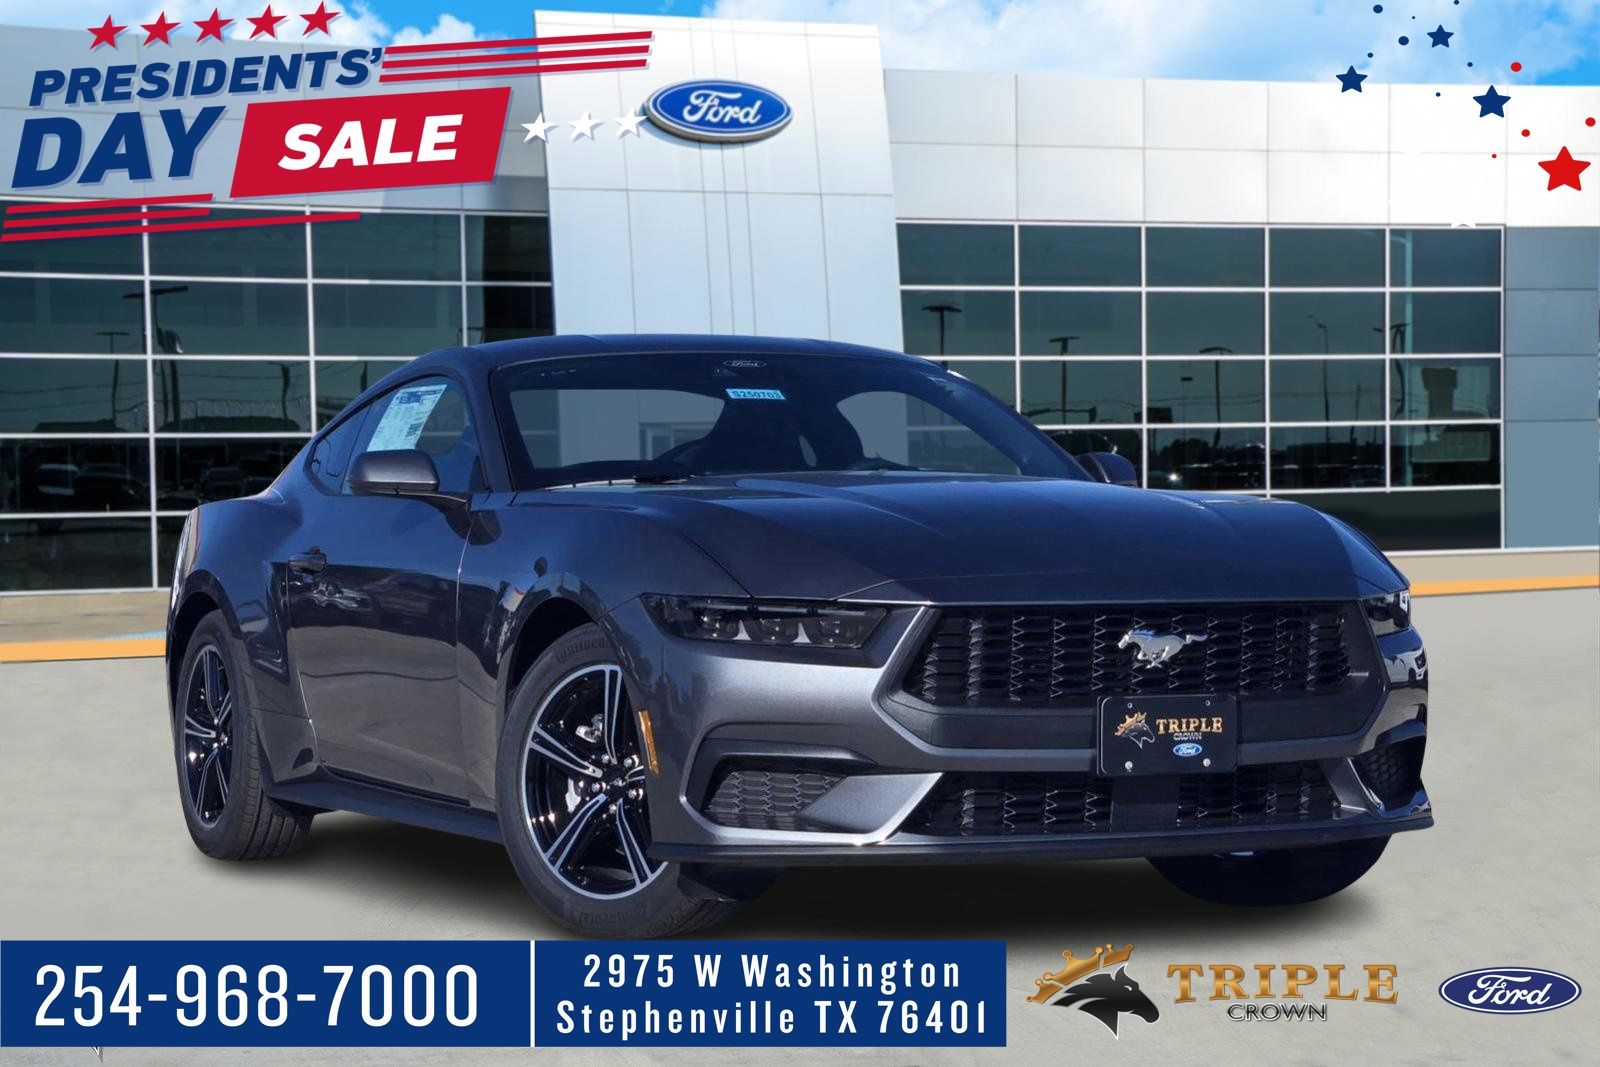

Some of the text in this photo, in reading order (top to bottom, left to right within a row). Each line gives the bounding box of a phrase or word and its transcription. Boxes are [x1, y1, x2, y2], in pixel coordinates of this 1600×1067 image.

[682, 89, 762, 124] Ford
[1155, 717, 1223, 735] TRIPLE
[1172, 732, 1202, 741] CROWN
